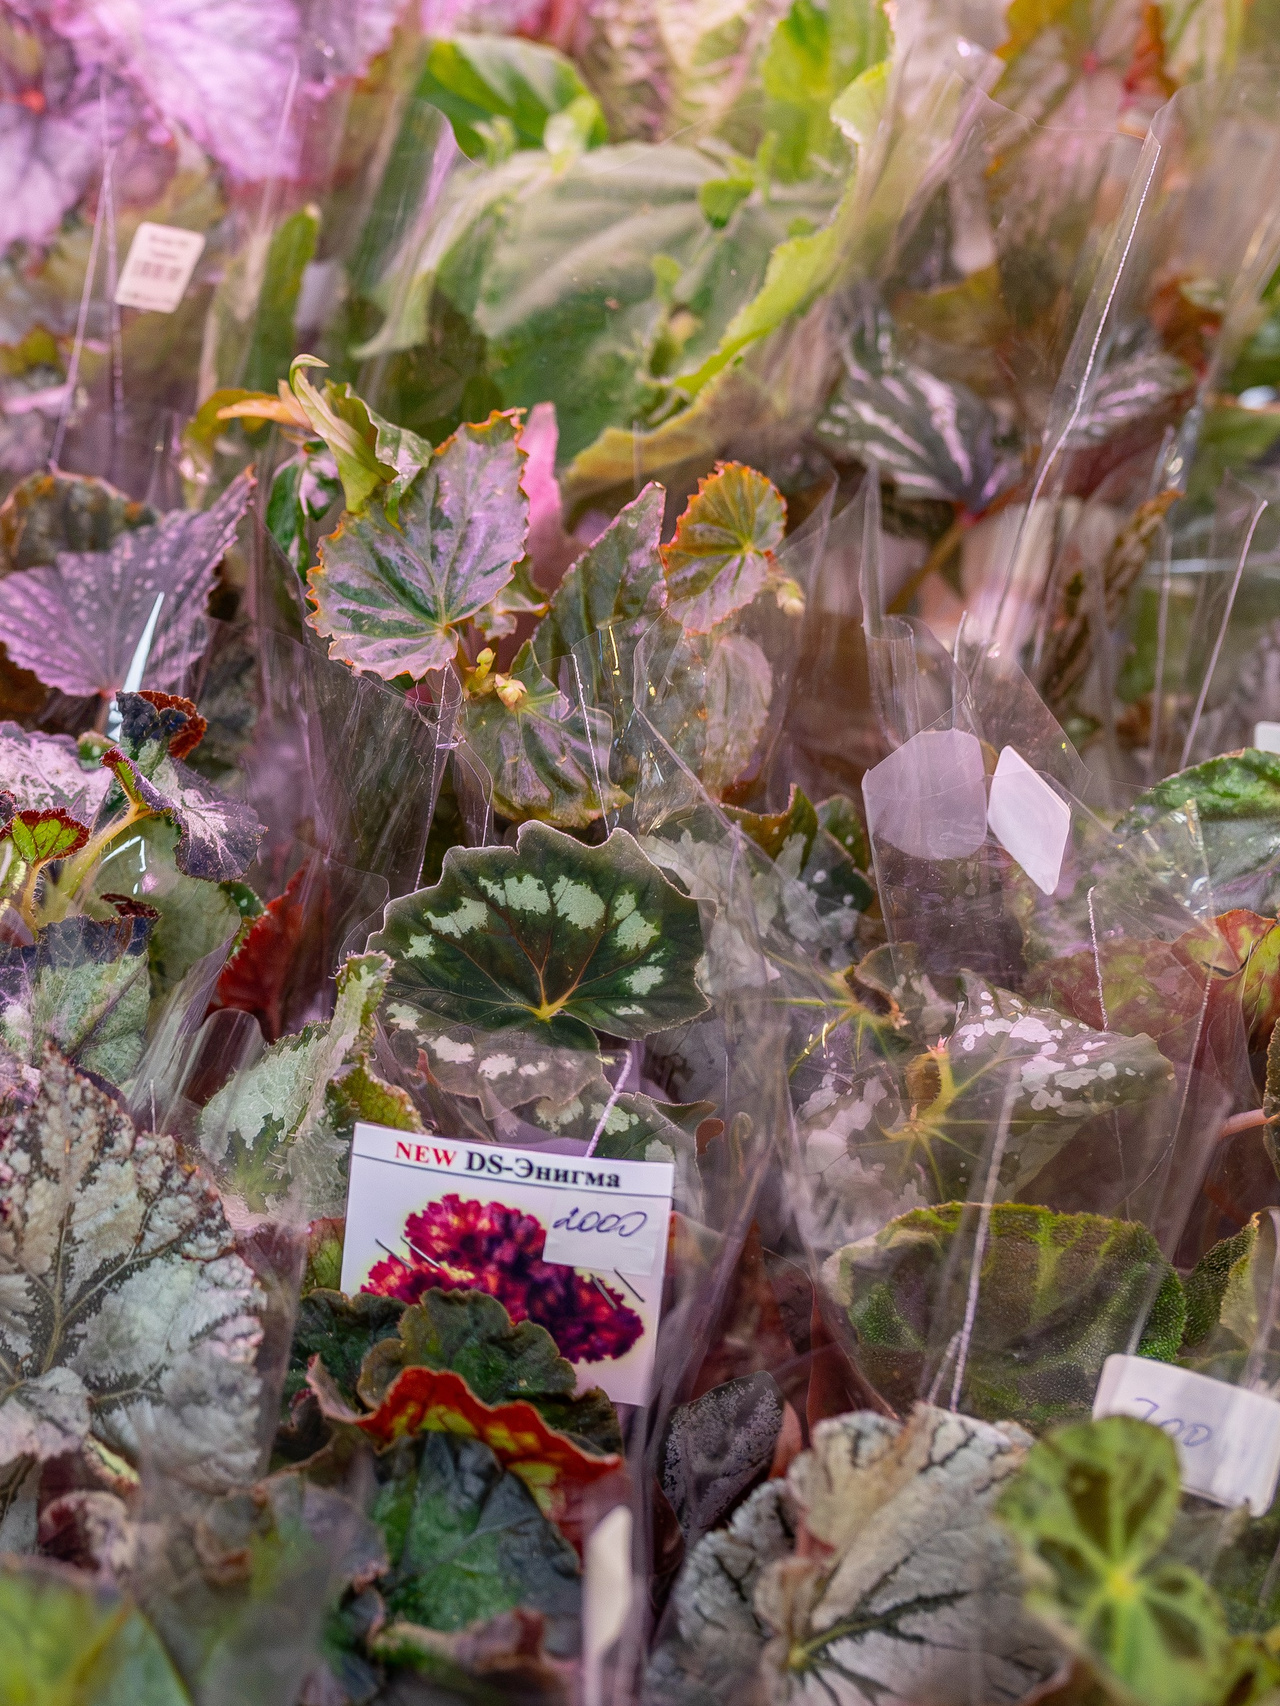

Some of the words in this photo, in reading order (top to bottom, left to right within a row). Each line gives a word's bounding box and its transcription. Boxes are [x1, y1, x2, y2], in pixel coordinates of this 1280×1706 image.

[395, 1141, 457, 1167] NEW
[465, 1150, 621, 1188] DS-Энигма
[552, 1207, 648, 1237] 2000
